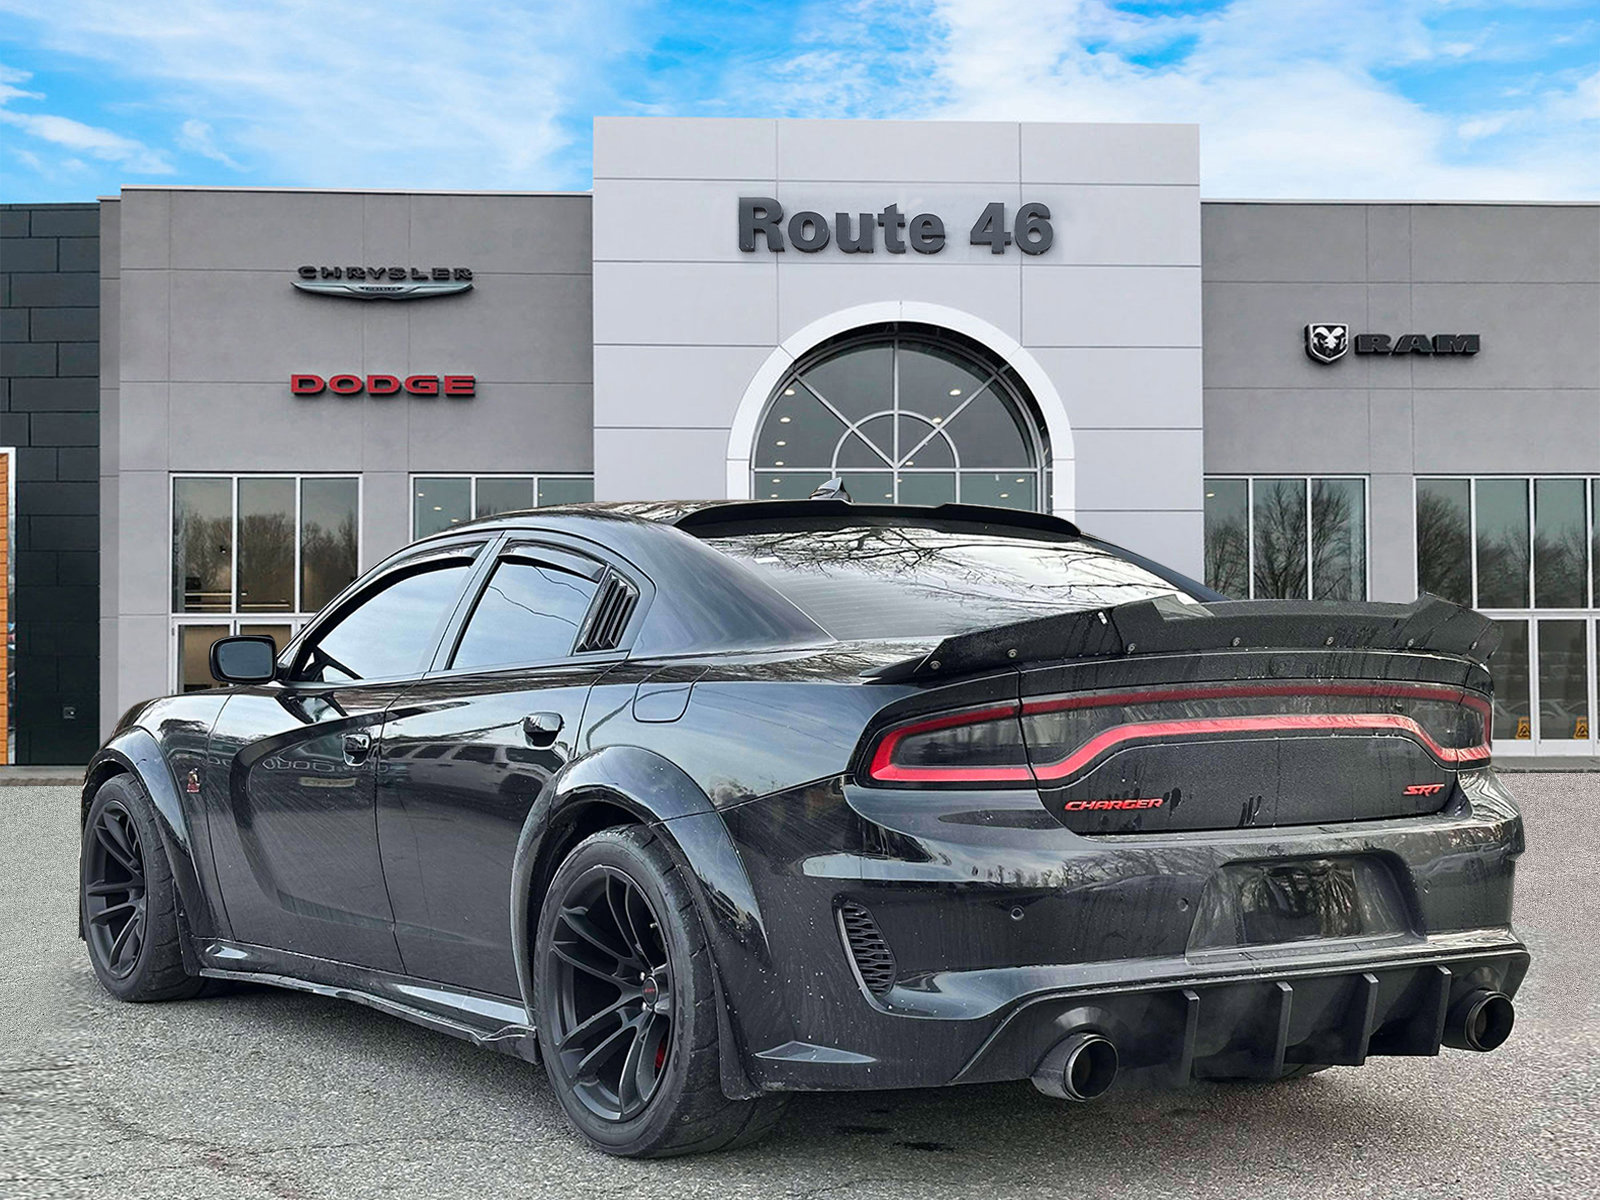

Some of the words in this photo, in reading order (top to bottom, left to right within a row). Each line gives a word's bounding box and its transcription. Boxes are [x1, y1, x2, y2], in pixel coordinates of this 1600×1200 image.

[739, 197, 945, 253] Route
[970, 203, 1053, 255] 46
[298, 266, 472, 281] CHRYSLER
[1354, 334, 1480, 355] RAM
[291, 374, 475, 396] DODGE
[1402, 783, 1445, 797] SRT
[1064, 798, 1164, 811] CHARGER
